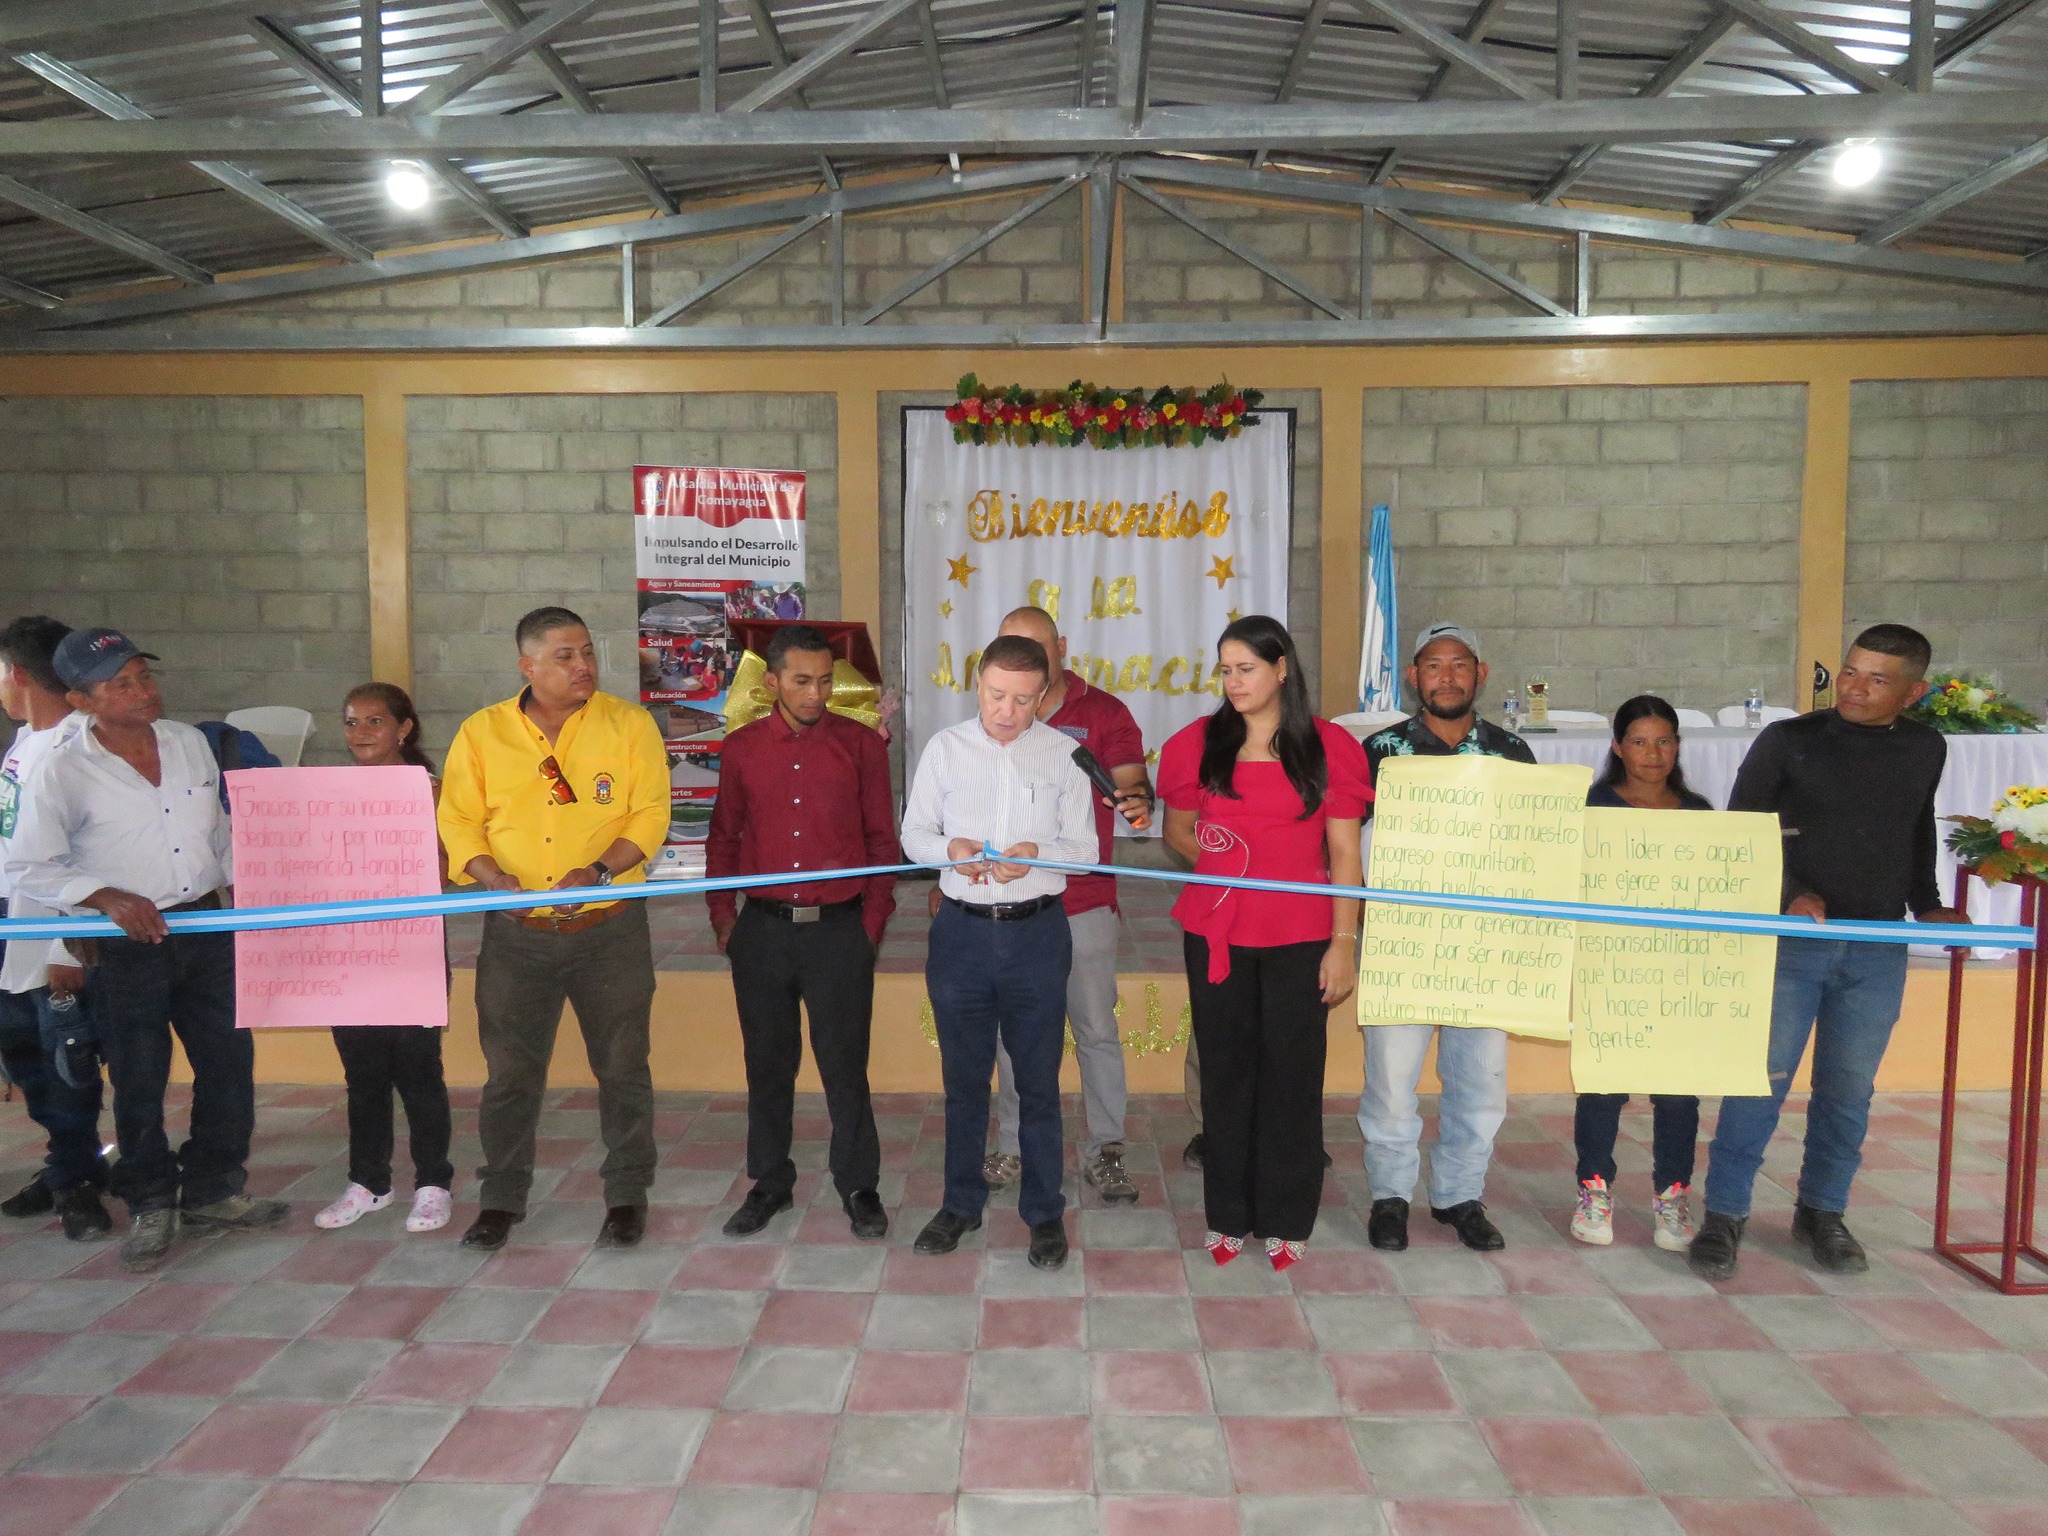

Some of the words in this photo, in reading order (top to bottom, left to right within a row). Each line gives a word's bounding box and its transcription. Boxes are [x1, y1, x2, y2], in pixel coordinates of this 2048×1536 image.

[697, 494, 767, 510] Comayagua
[722, 479, 778, 493] Municipal
[780, 481, 795, 493] de
[966, 488, 1230, 543] Bienvenidos
[644, 535, 719, 551] Impulsando
[721, 538, 732, 549] el
[735, 538, 800, 552] Desarrollo
[655, 553, 704, 567] Integral
[707, 553, 726, 566] del
[729, 555, 791, 569] Municipio
[647, 580, 667, 590] Agua
[673, 580, 721, 589] Saneamiento
[1027, 577, 1061, 622] a
[1084, 574, 1143, 621] la
[647, 638, 673, 648] Salud
[649, 690, 687, 700] Educación
[666, 743, 708, 751] aestructura
[671, 789, 693, 797] ortes
[1409, 781, 1484, 807] innovación
[1494, 792, 1504, 820] y
[1508, 791, 1586, 821] compromiso
[307, 798, 336, 833] por
[339, 800, 356, 817] su
[1376, 805, 1402, 834] han
[1410, 807, 1440, 836] sido
[1445, 809, 1482, 840] clave
[1489, 821, 1521, 851] para
[1524, 815, 1579, 846] nuestro
[320, 830, 334, 859] y
[343, 829, 367, 860] por
[374, 828, 427, 847] marcar
[1372, 844, 1434, 877] progreso
[1443, 844, 1536, 877] comunitario,
[1582, 827, 1611, 859] Un
[1674, 843, 1696, 861] es
[1705, 837, 1754, 875] aquel
[237, 859, 267, 878] una
[273, 851, 354, 881] diferencia
[360, 846, 427, 889] tangible
[1579, 871, 1607, 903] que
[1615, 869, 1660, 901] ejerce
[1671, 875, 1689, 893] su
[1698, 867, 1751, 906] poder
[1367, 905, 1433, 936] perduran
[1440, 912, 1470, 942] por
[1474, 915, 1574, 945] generaciones.
[243, 948, 268, 967] son
[275, 937, 400, 967] verdaderamente
[1365, 935, 1425, 959] Gracias
[1433, 942, 1461, 971] por
[1467, 945, 1495, 965] ser
[1502, 939, 1563, 969] nuestro
[1579, 926, 1711, 964] responsabilidad
[1723, 931, 1744, 957] el
[1361, 968, 1405, 1000] mayor
[1411, 966, 1500, 997] constructor
[1506, 968, 1528, 998] de
[1535, 981, 1557, 1001] un
[1578, 966, 1605, 997] que
[1613, 954, 1664, 985] busca
[1673, 959, 1690, 987] el
[1702, 957, 1745, 988] bien
[1362, 999, 1416, 1022] futuro
[1581, 998, 1593, 1031] y
[1605, 988, 1649, 1017] hace
[1660, 988, 1719, 1018] brillar
[1729, 1000, 1751, 1019] su
